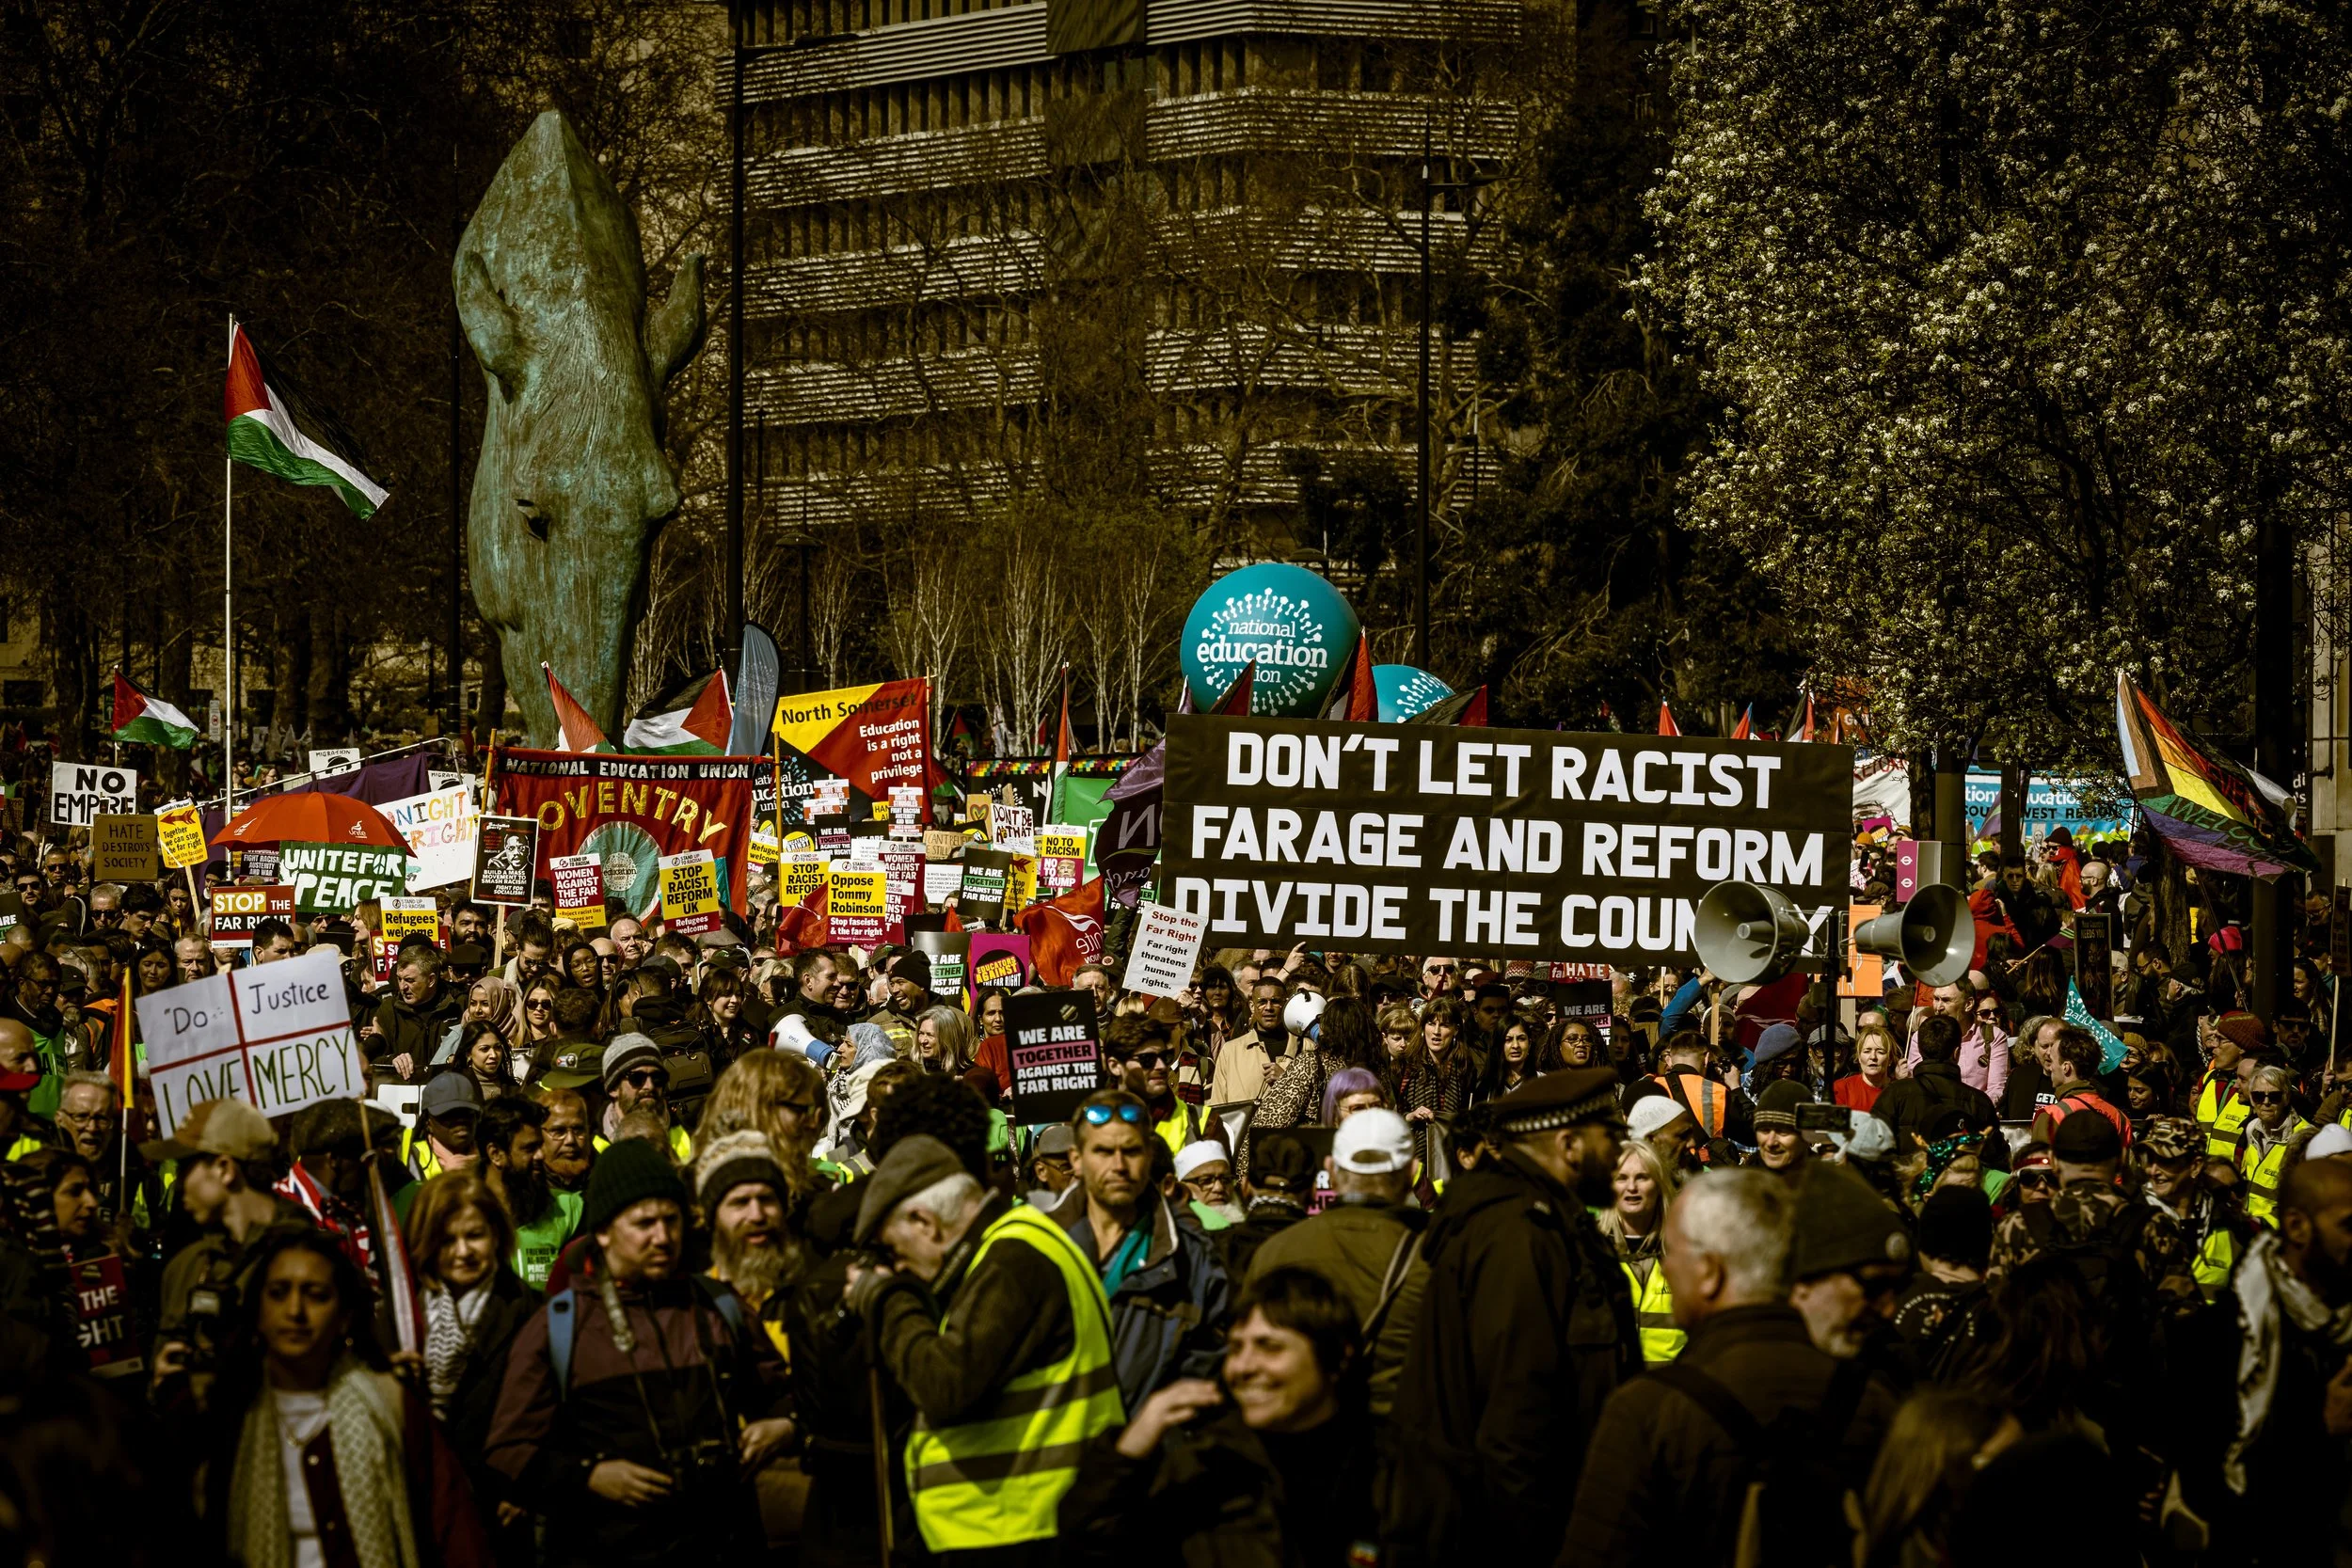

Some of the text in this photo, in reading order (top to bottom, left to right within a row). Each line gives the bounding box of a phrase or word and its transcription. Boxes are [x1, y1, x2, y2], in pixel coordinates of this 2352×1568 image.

[1228, 620, 1295, 638] national
[1197, 635, 1327, 668] education
[1232, 667, 1280, 684] uion
[782, 693, 917, 725] North Somerset
[859, 719, 920, 737] Education
[866, 732, 921, 752] is a right
[892, 749, 922, 762] not a
[505, 757, 749, 779] NATIONAL EDUCATION UNION
[871, 764, 922, 784] privilege
[1228, 732, 1399, 793] DON'T
[1419, 739, 1532, 798] LET
[1551, 747, 1782, 810] RACIST
[75, 768, 126, 794] NO
[54, 792, 135, 825] EMPRE
[523, 782, 727, 844] OVENTRY
[760, 800, 790, 812] unin
[1022, 810, 1032, 827] BE
[109, 824, 144, 839] HATE
[163, 827, 187, 838] Together
[186, 832, 199, 841] stop
[1007, 826, 1032, 838] THAT
[103, 841, 151, 852] DESTROYS
[188, 838, 202, 848] right
[1046, 837, 1073, 847] NO TO
[1191, 806, 1422, 869] FARAGE
[1444, 817, 1563, 874] AND
[1582, 821, 1824, 887] REFORM
[884, 854, 915, 863] WOMEN
[1045, 847, 1080, 856] RACISM
[103, 857, 148, 868] SOCIETY
[284, 848, 357, 873] UNITE
[884, 863, 920, 871] AGAINST
[1044, 858, 1057, 867] NO
[555, 867, 594, 880] WOMEN
[603, 868, 637, 877] education
[673, 865, 703, 879] STOP
[747, 863, 763, 873] Stop
[792, 864, 819, 874] STOP
[885, 871, 916, 879] THE FAR
[969, 866, 1003, 877] WE ARE
[1043, 867, 1057, 877] TO
[556, 877, 598, 889] AGAINST
[668, 876, 708, 893] RACIST
[788, 873, 824, 883] RACIST
[831, 874, 874, 888] Oppose
[966, 878, 1003, 887] TOGETHER
[1043, 877, 1076, 887] TRUMP
[294, 873, 393, 909] PEACE
[557, 886, 597, 898] THE FAR
[667, 887, 712, 905] REFORM
[831, 888, 872, 902] Tommy
[962, 892, 1002, 903] FAR RIGHT
[215, 894, 291, 912] STOP THE
[559, 896, 589, 907] RIGHT
[683, 902, 698, 914] UK
[831, 902, 883, 914] Robinson
[215, 916, 242, 930] FAR
[385, 913, 436, 927] Refugees
[675, 915, 708, 927] Refugees
[831, 917, 879, 927] Stop fascists
[884, 913, 901, 924] FAR
[1152, 911, 1199, 928] Stop the
[1174, 878, 1407, 941] DIVIDE
[1429, 889, 1542, 946] THE
[1561, 895, 1834, 958] COUNY
[837, 927, 850, 935] the
[851, 927, 863, 935] far
[865, 927, 883, 937] right
[1146, 924, 1197, 943] Far Right
[2081, 929, 2096, 940] NEEDS
[1147, 940, 1188, 956] Far right
[940, 954, 961, 964] ARE
[977, 956, 1016, 974] EDUCATORS
[1141, 951, 1187, 968] threatens
[976, 964, 1018, 984] AGAINST
[1144, 964, 1176, 978] human
[1565, 963, 1605, 977] HATE
[994, 973, 1022, 987] FAR RIGHT
[1142, 977, 1171, 990] rights.
[249, 981, 330, 1015] Justice
[1564, 1004, 1606, 1016] WE ARE
[1018, 1025, 1086, 1045] WE ARE
[1016, 1045, 1092, 1065] TOGETHER
[163, 1027, 351, 1119] LOVE MERCY
[1017, 1062, 1096, 1080] AGAINST THE
[1018, 1074, 1097, 1094] FAR RIGHT
[78, 1284, 119, 1312] THE
[76, 1314, 124, 1349] GHT
